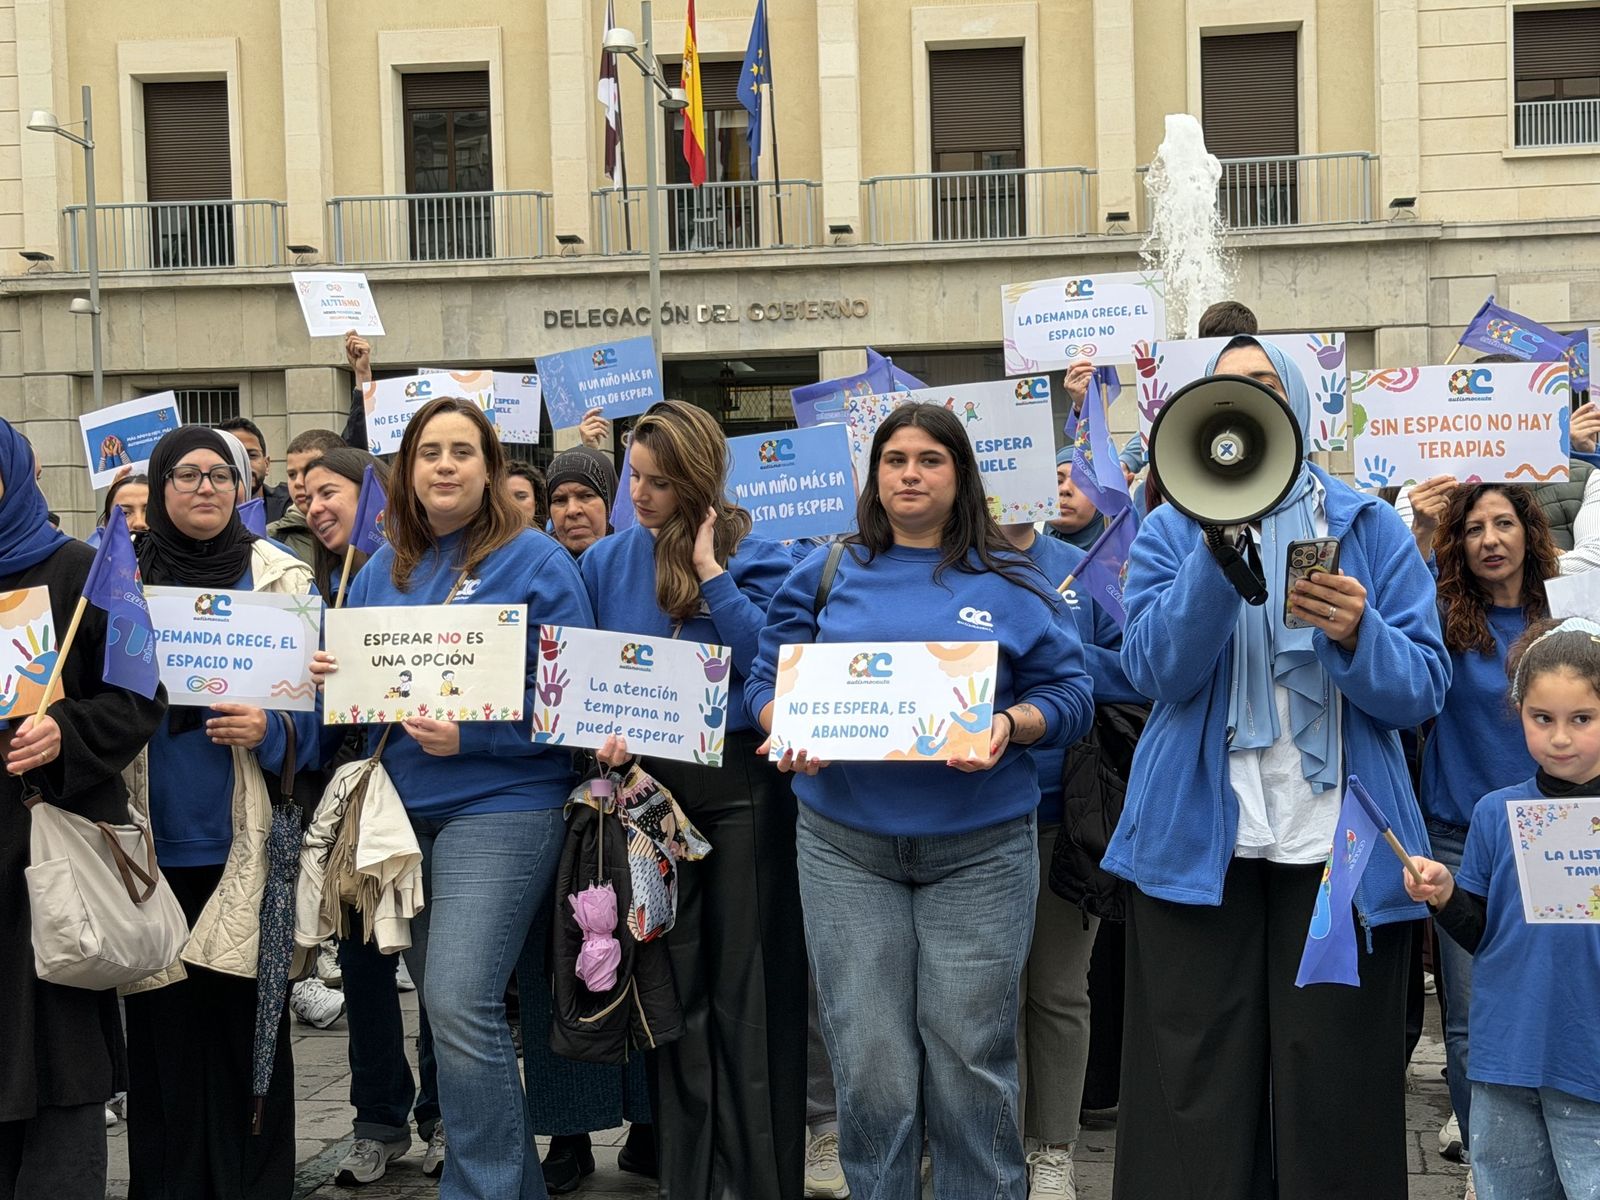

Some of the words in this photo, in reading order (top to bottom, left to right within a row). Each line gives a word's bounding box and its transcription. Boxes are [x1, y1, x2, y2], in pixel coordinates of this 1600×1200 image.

[321, 298, 360, 307] AUTISMO
[544, 301, 689, 329] DELEGACÓN
[697, 303, 740, 323] DEL
[748, 298, 869, 322] GOBIERNO
[1018, 315, 1033, 326] LA
[1035, 309, 1089, 324] DEMANDA
[1092, 305, 1132, 318] CRECE,
[1134, 304, 1148, 315] EL
[1049, 327, 1096, 341] ESPACIO
[1099, 325, 1115, 337] NO
[622, 368, 641, 384] MÁS
[585, 395, 608, 409] LISTA
[607, 393, 620, 404] DE
[621, 386, 654, 402] ESPERA
[374, 416, 386, 426] NO
[388, 414, 399, 424] ES
[1370, 418, 1399, 437] SIN
[1404, 414, 1483, 435] ESPACIO
[1488, 414, 1513, 432] NO
[1518, 412, 1553, 431] HAY
[975, 436, 1033, 453] ESPERA
[1418, 440, 1506, 460] TERAPIAS
[979, 458, 1018, 473] UELE
[800, 469, 828, 490] MÁS
[779, 503, 795, 519] DE
[797, 497, 844, 516] ESPERA
[226, 632, 278, 650] CRECE,
[280, 636, 298, 650] EL
[364, 632, 433, 646] ESPERAR
[437, 631, 462, 644] NO
[466, 631, 484, 644] ES
[166, 654, 229, 670] ESPACIO
[232, 657, 254, 671] NO
[371, 653, 406, 667] UNA
[411, 649, 475, 666] OPCIÓN
[589, 677, 609, 692] La
[613, 681, 678, 701] atención
[584, 698, 659, 723] temprana
[663, 710, 680, 723] no
[788, 701, 808, 715] NO
[812, 702, 830, 715] ES
[833, 701, 894, 716] ESPERA,
[898, 701, 917, 714] ES
[576, 720, 623, 736] puede
[627, 726, 685, 745] esperar
[811, 725, 889, 738] ABANDONO
[1544, 850, 1565, 861] LA
[1563, 866, 1600, 876] TAM
